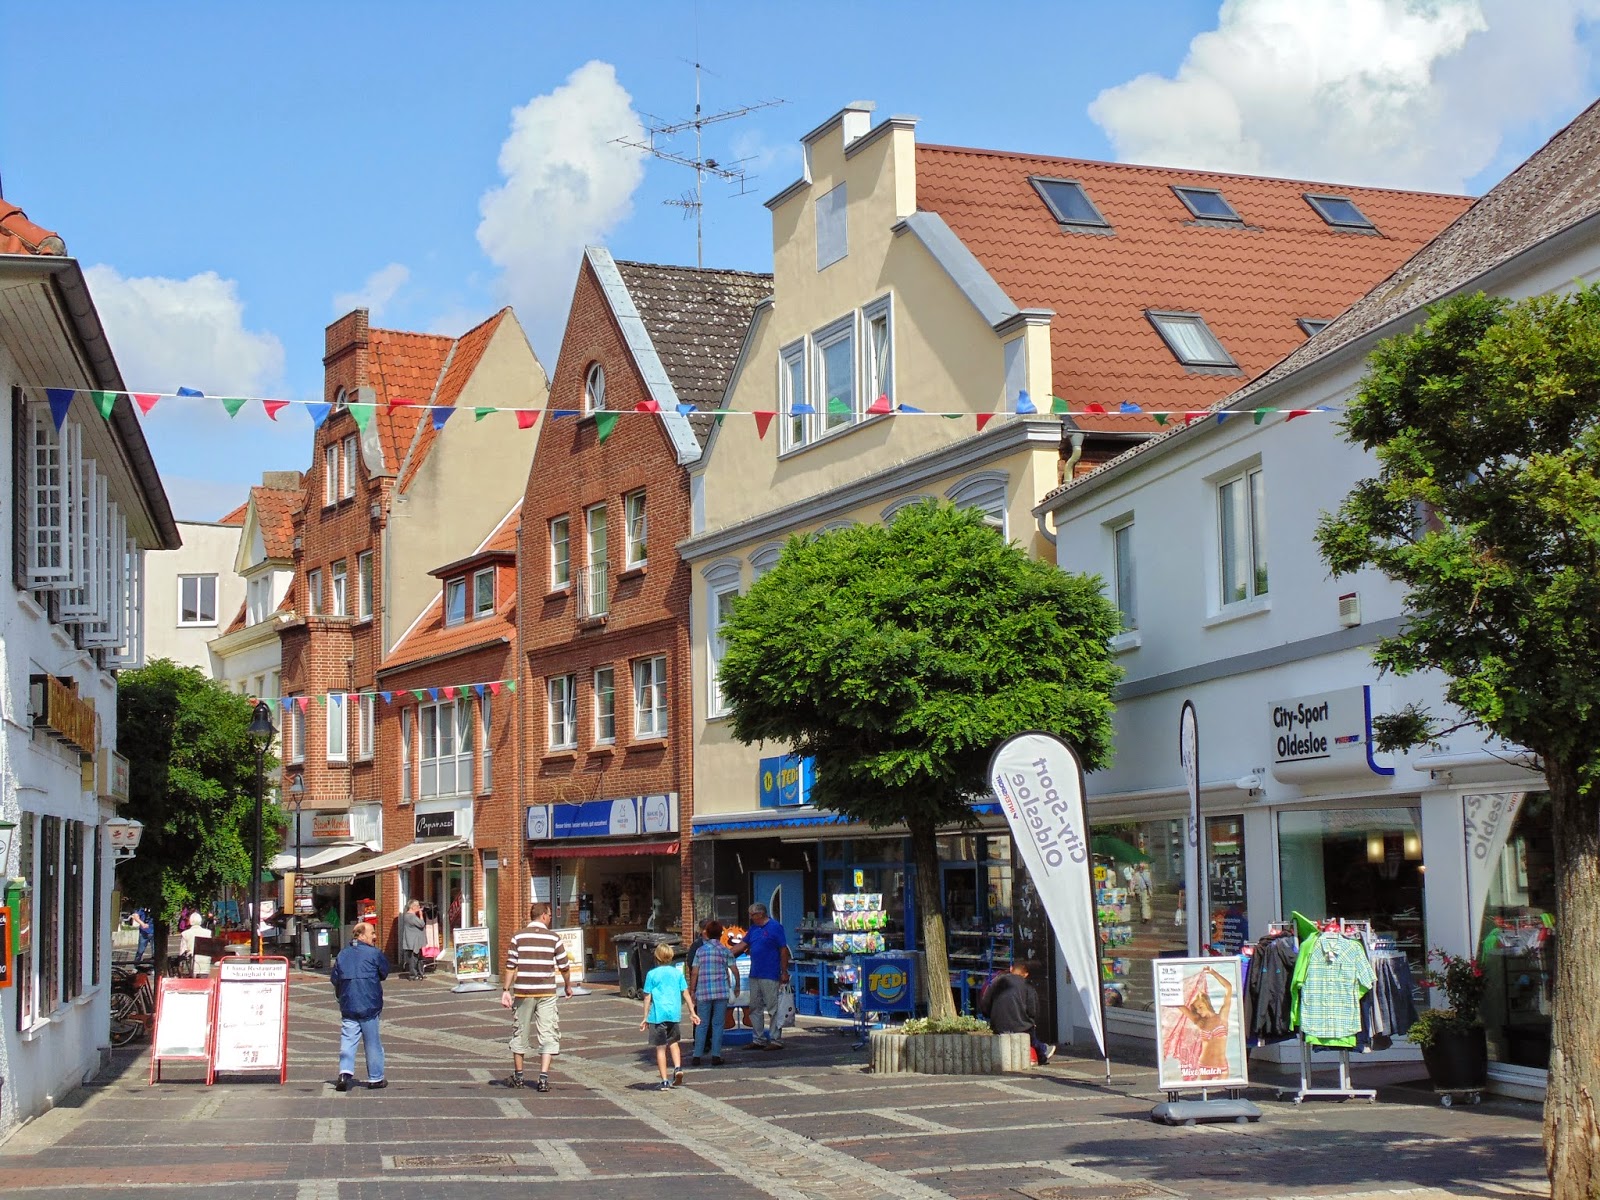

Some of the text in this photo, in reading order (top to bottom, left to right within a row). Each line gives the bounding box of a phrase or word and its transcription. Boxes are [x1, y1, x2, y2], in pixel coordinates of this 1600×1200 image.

[1273, 701, 1329, 732] City-Sport
[1277, 731, 1328, 757] Oldesloe
[416, 817, 454, 836] Paparazzi
[868, 971, 907, 991] TEDi
